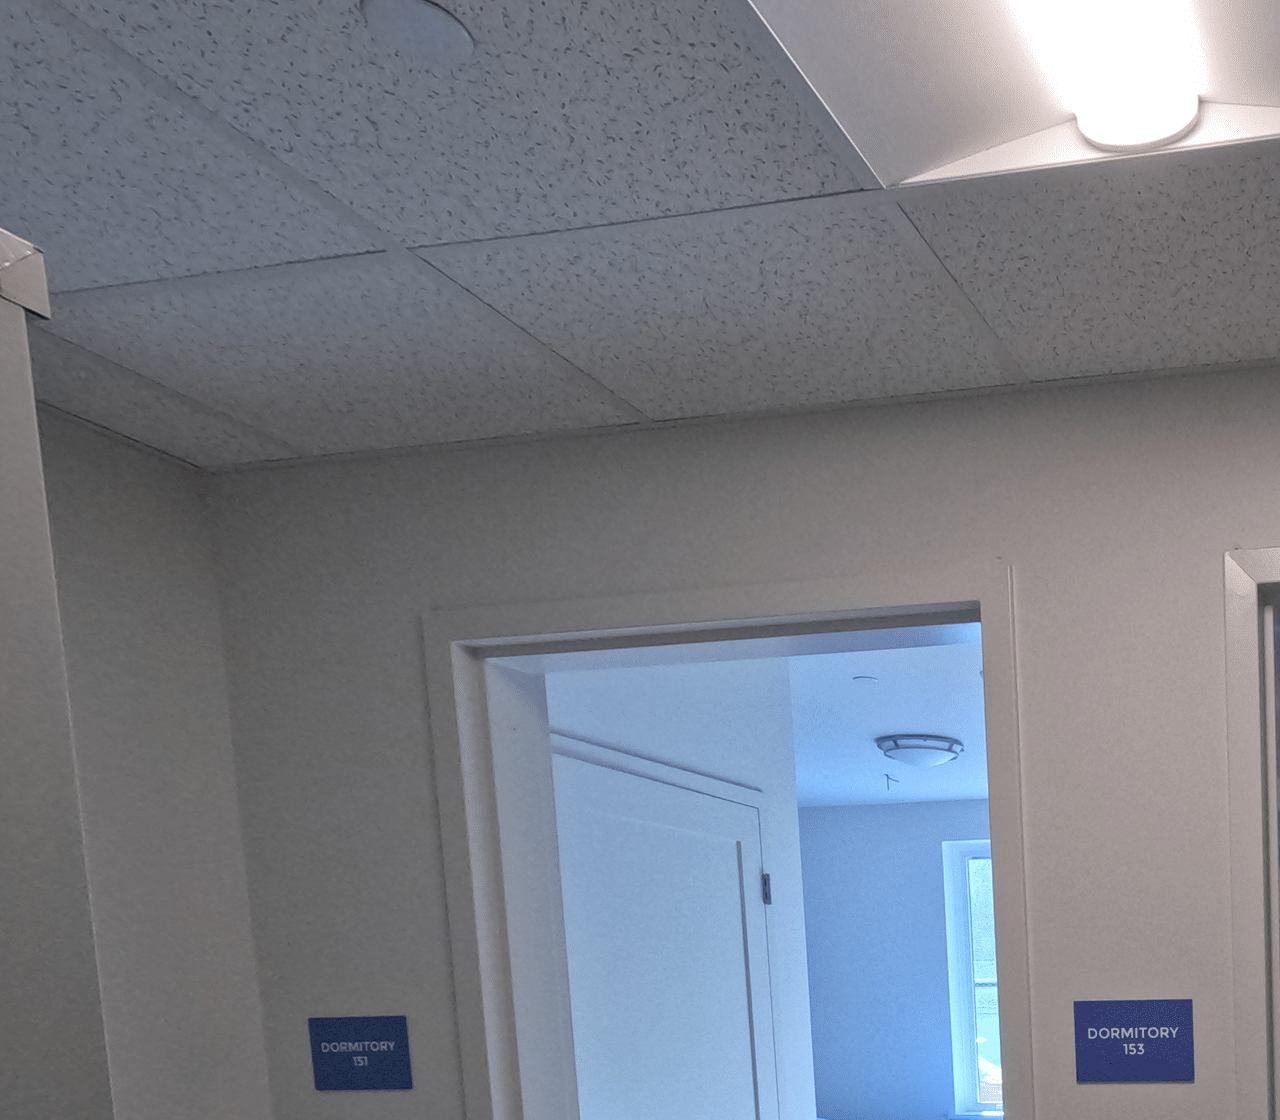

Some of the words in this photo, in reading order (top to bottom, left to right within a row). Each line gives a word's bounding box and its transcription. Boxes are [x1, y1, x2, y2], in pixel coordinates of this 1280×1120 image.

[1087, 1027, 1179, 1039] DORMITORY
[321, 1041, 396, 1052] DORMITORY
[1122, 1043, 1145, 1055] 153
[352, 1055, 368, 1067] 151
